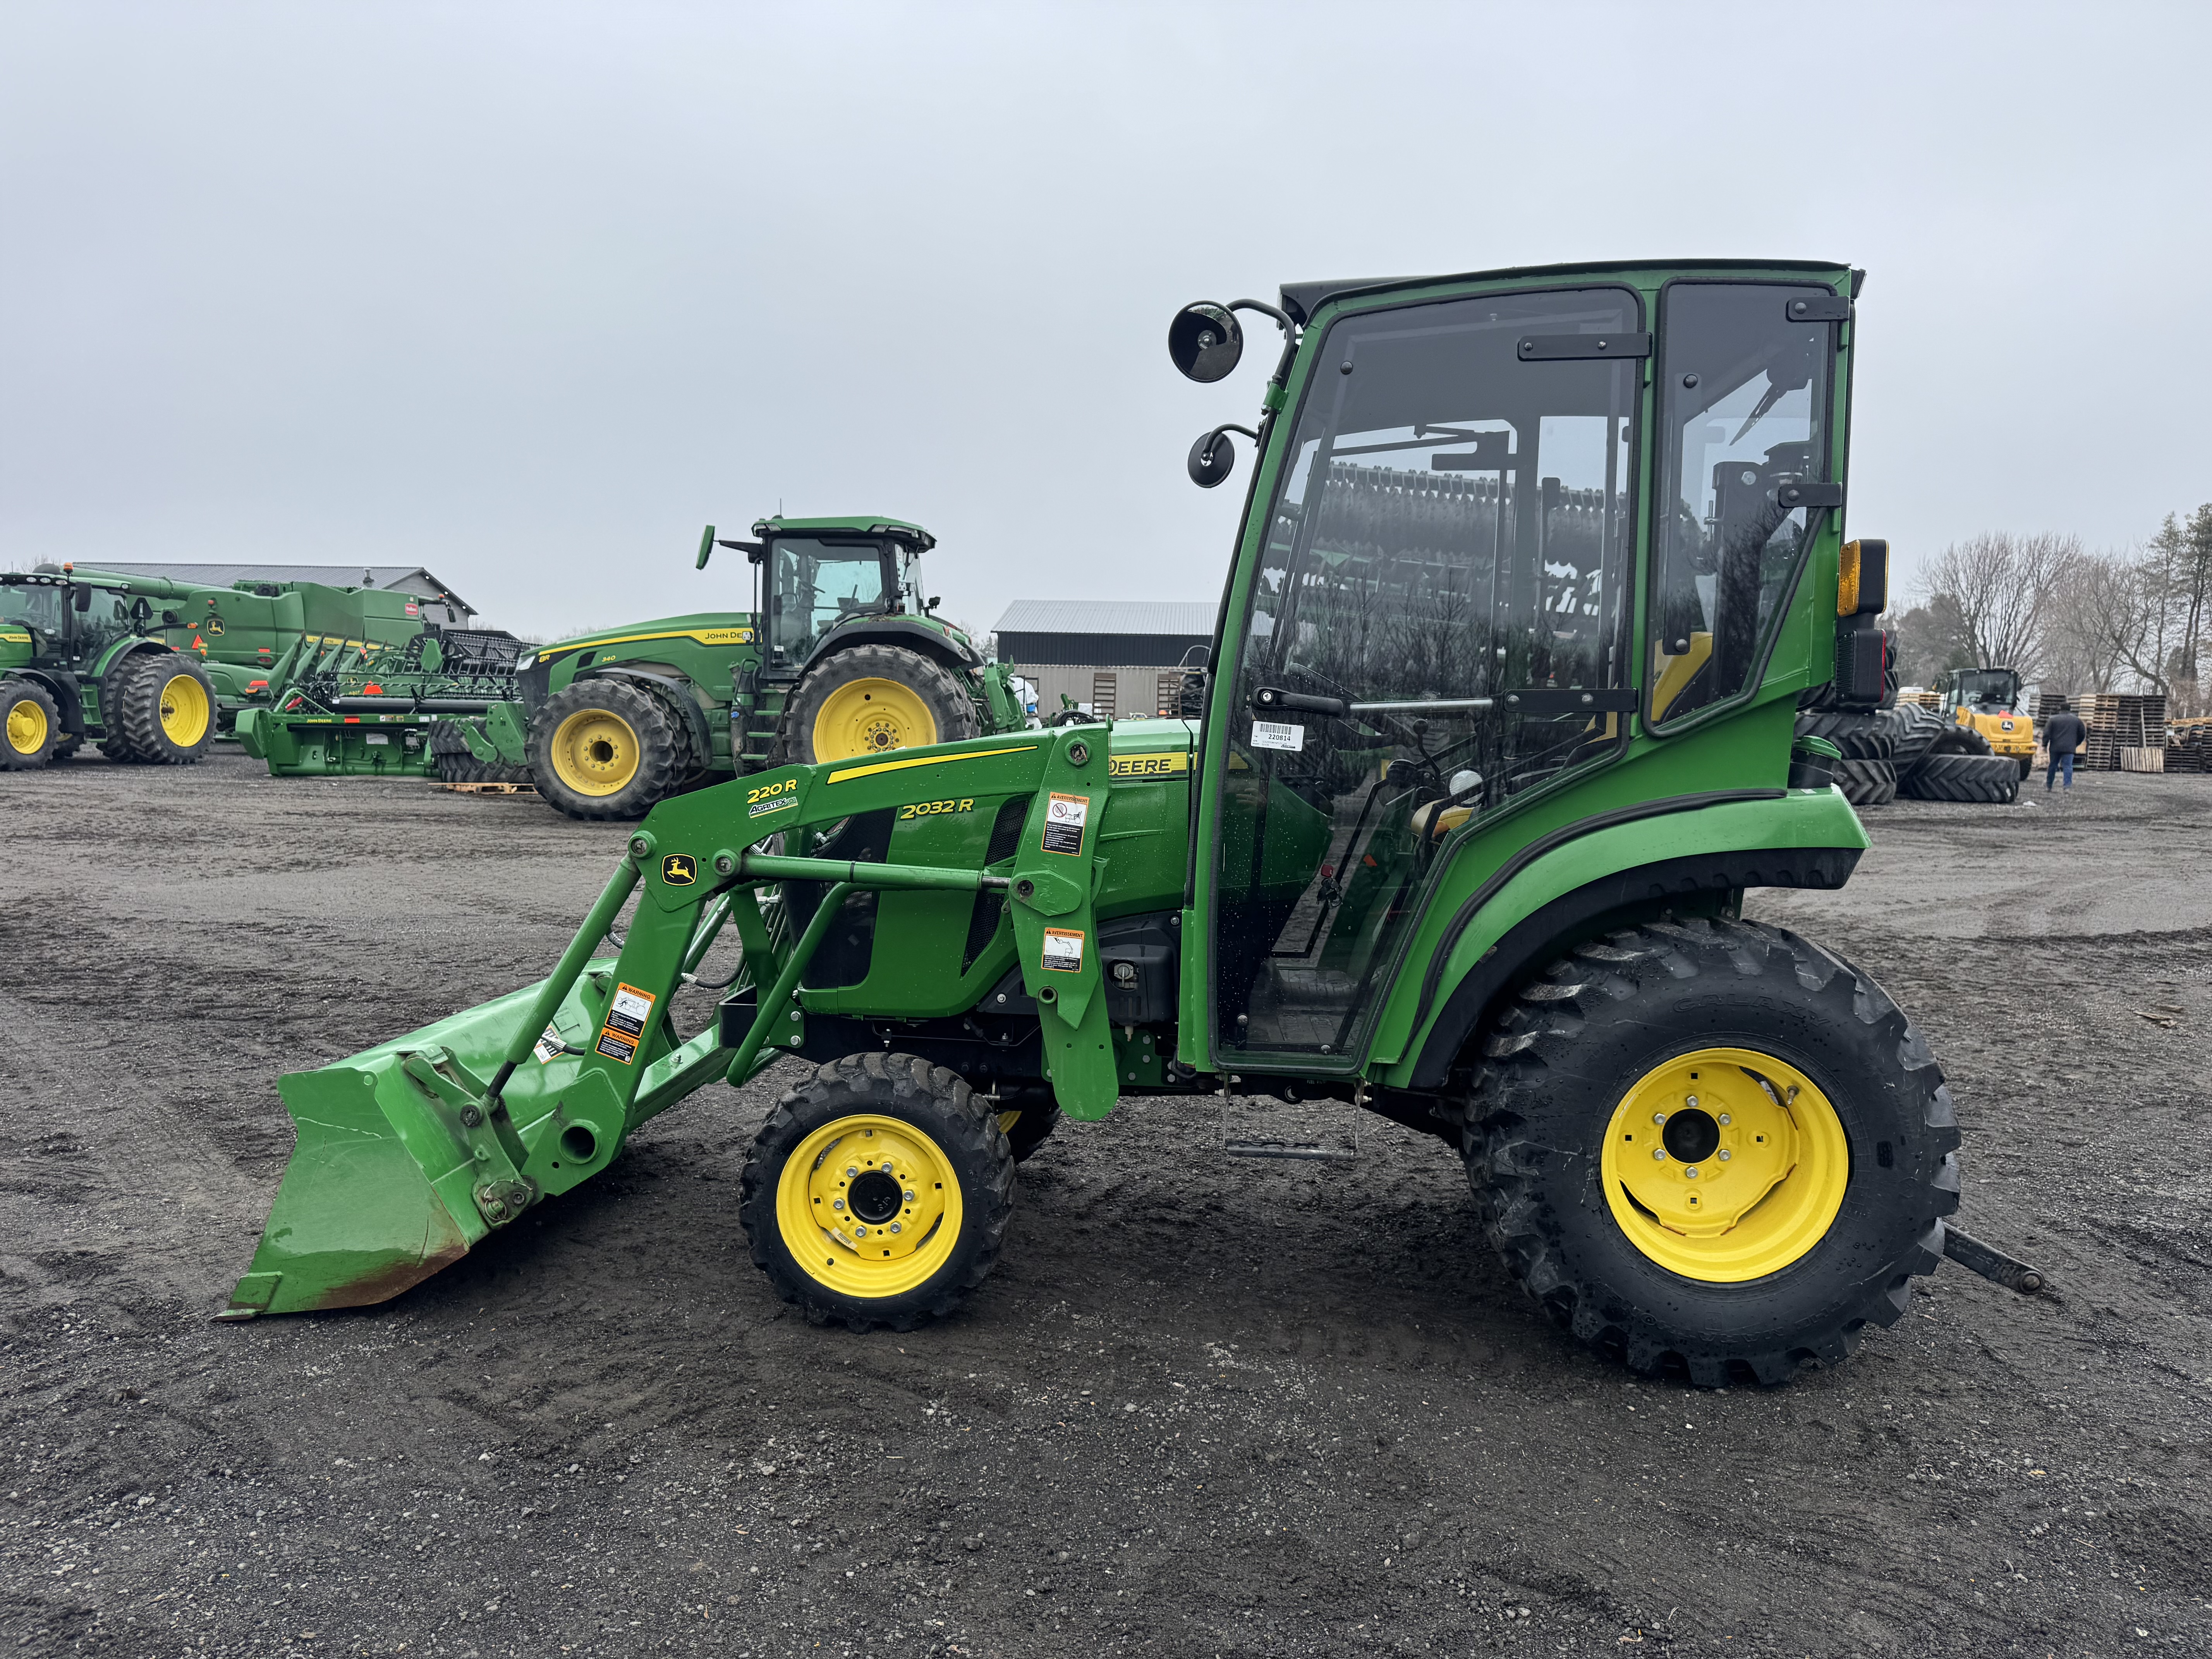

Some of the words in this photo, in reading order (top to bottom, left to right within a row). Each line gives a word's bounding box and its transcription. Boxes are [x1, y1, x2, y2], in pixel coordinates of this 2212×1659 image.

[539, 654, 550, 663] 8R
[750, 799, 787, 814] AGRITEX
[629, 988, 650, 999] WARNING
[1673, 993, 1831, 1027] GALAXY
[612, 1033, 634, 1044] WARNING
